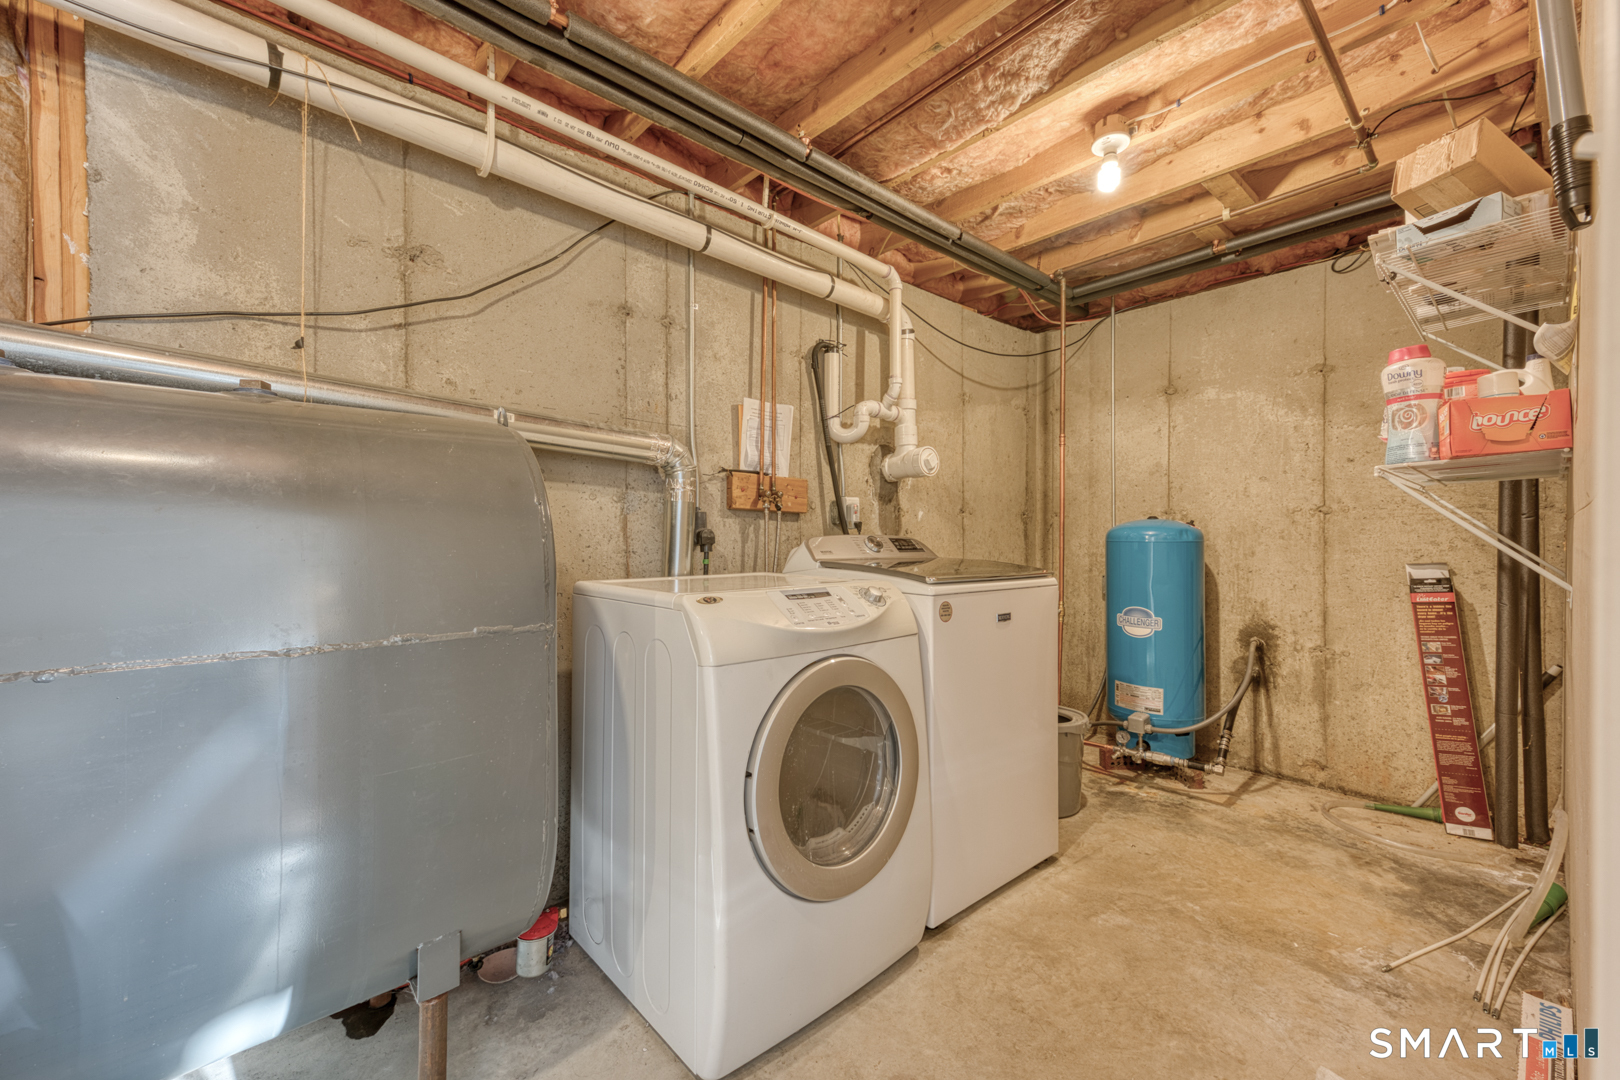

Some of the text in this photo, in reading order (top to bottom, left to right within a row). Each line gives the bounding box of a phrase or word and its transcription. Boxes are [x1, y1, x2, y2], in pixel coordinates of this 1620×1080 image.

[603, 138, 621, 151] DWV
[692, 179, 714, 194] SCH40
[1387, 369, 1423, 381] Downy
[1472, 405, 1547, 430] bounce
[1118, 615, 1159, 628] CHALLENGER
